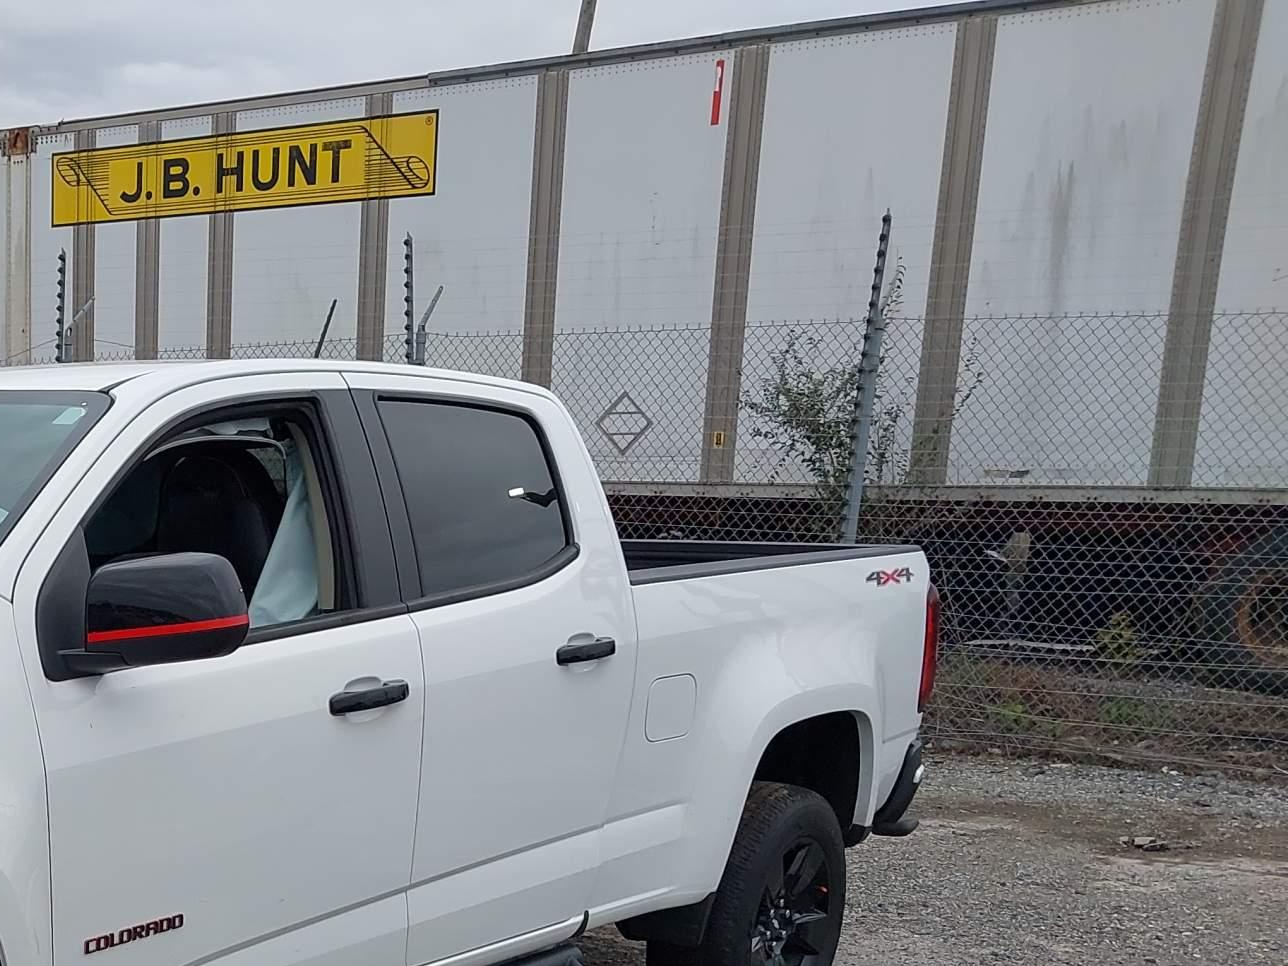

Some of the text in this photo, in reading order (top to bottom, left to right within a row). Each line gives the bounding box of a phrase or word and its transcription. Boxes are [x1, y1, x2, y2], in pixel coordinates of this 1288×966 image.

[119, 139, 353, 204] J.B. HUNT
[83, 913, 185, 955] COLORADO
